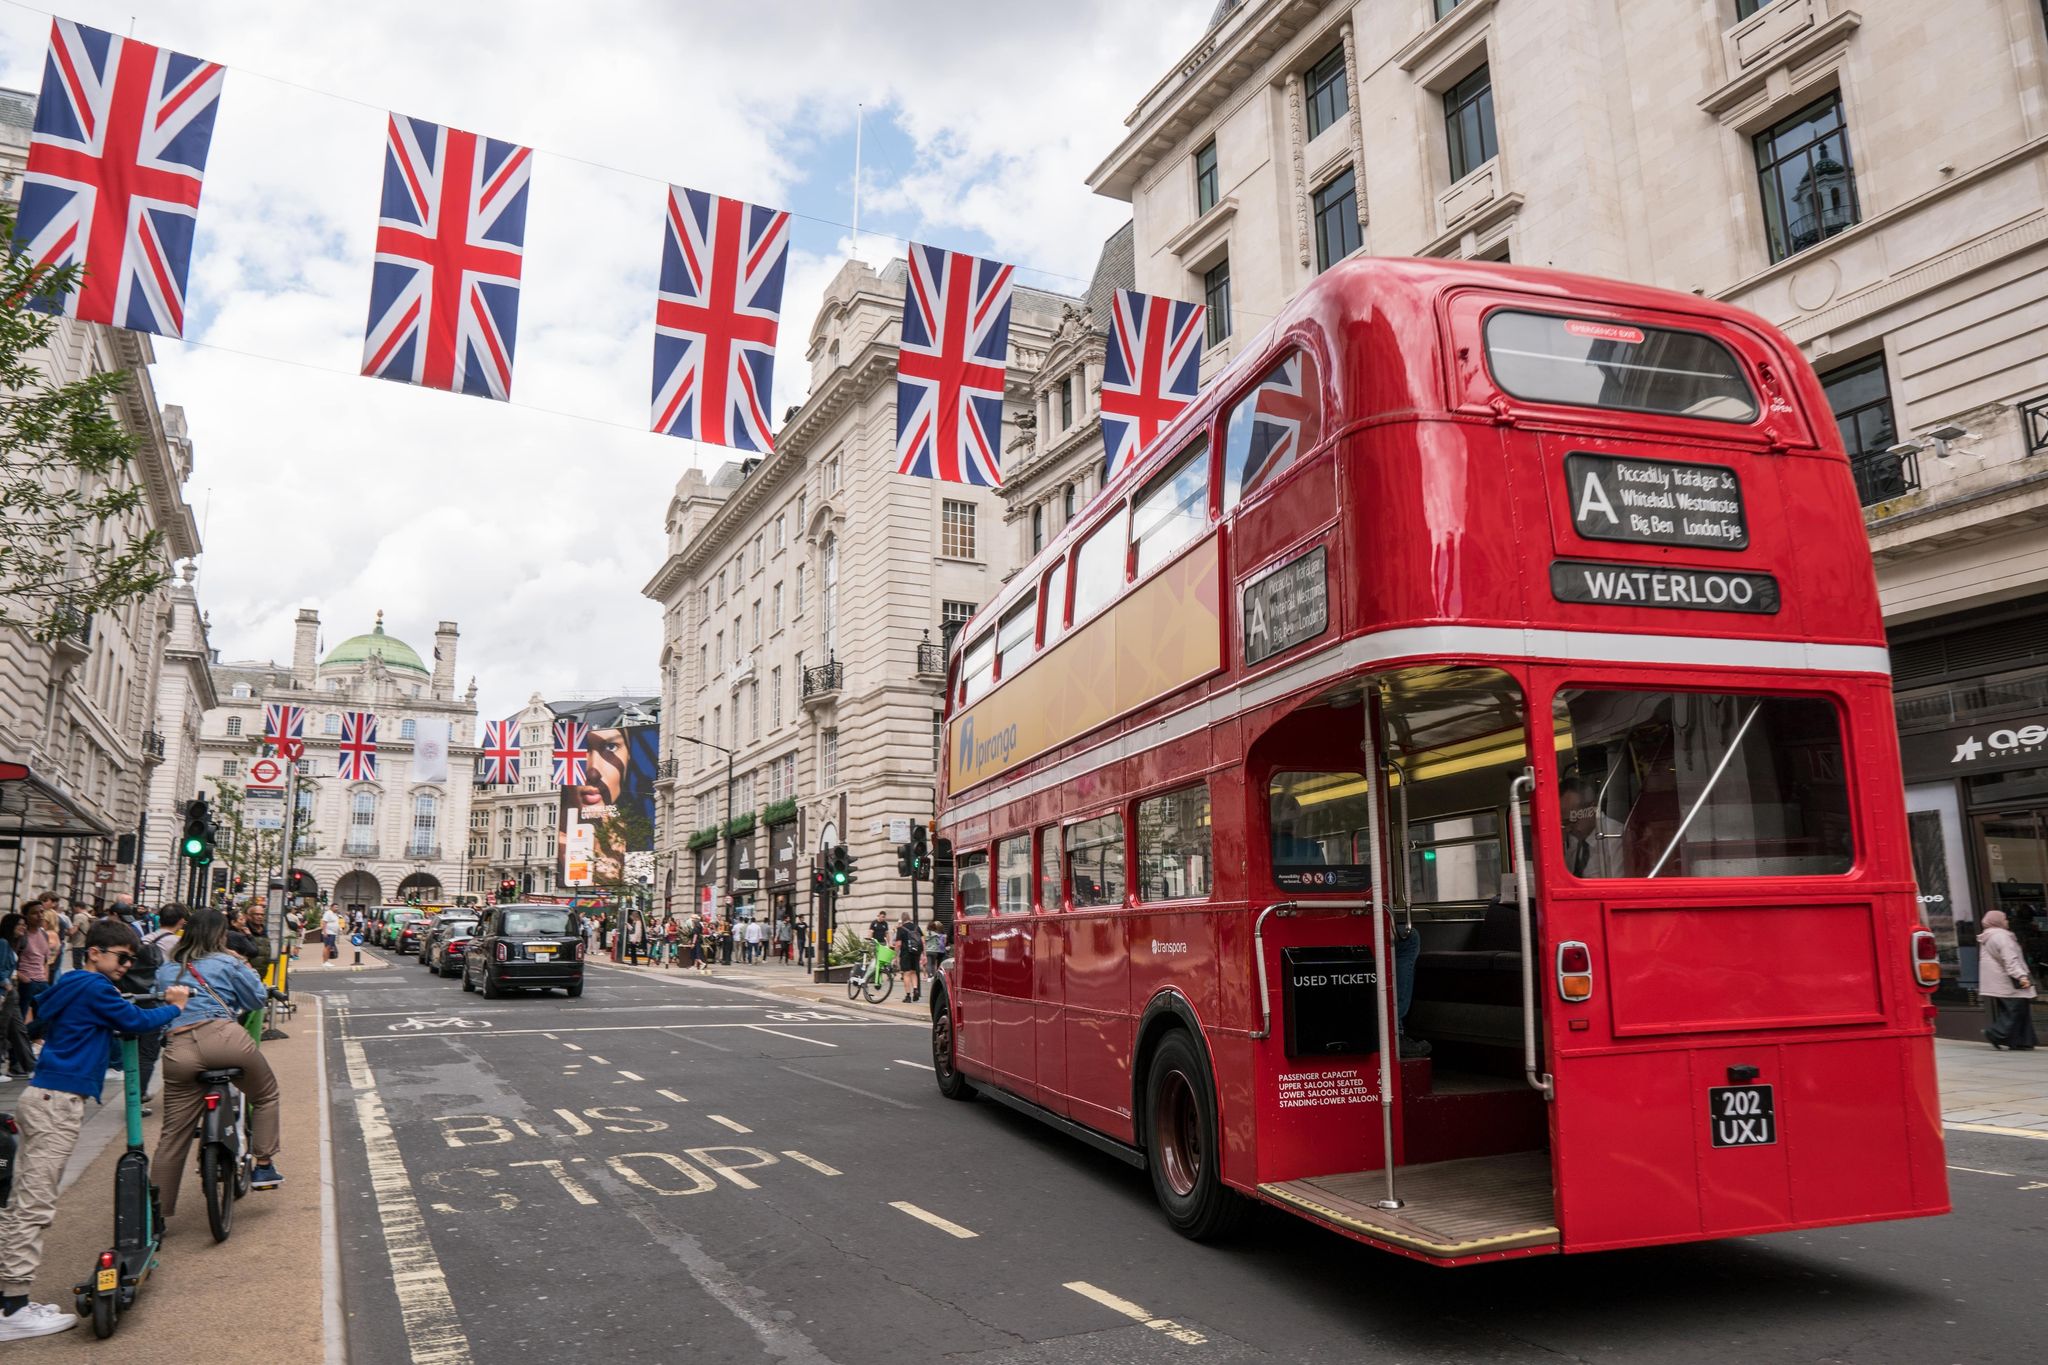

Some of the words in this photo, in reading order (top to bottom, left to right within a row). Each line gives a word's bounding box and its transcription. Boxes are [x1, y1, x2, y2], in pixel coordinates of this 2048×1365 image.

[1570, 324, 1617, 336] EMERGENCY
[1618, 329, 1636, 338] EXIT
[1617, 464, 1670, 490] Piccadilly
[1673, 468, 1719, 492] Trafalgar
[1577, 472, 1619, 524] A
[1620, 489, 1675, 509] Whitehall
[1630, 514, 1650, 535] Big
[1651, 516, 1674, 534] Ben
[1683, 518, 1721, 537] London
[1720, 520, 1742, 541] Eye
[1584, 571, 1752, 604] WATERLOO
[1250, 597, 1268, 647] A
[976, 723, 1017, 775] ipiranga
[1987, 724, 2048, 749] as
[288, 743, 301, 756] Y
[1157, 941, 1187, 956] transpora
[1293, 975, 1327, 987] USED
[1331, 973, 1377, 985] TICKETS
[1278, 1072, 1320, 1082] PASSENGER
[1321, 1070, 1358, 1080] CAPACITY
[1278, 1081, 1302, 1091] UPPER
[1304, 1080, 1335, 1089] SALOON
[1336, 1078, 1364, 1087] SEATED
[1279, 1090, 1305, 1099] LOWER
[1308, 1088, 1339, 1098] SALOON
[1340, 1086, 1368, 1095] SEATED
[1348, 1094, 1379, 1103] SALOON
[1722, 1090, 1762, 1115] 202
[432, 1106, 670, 1147] BUS
[1719, 1118, 1768, 1144] UXJ
[420, 1145, 781, 1213] STOP
